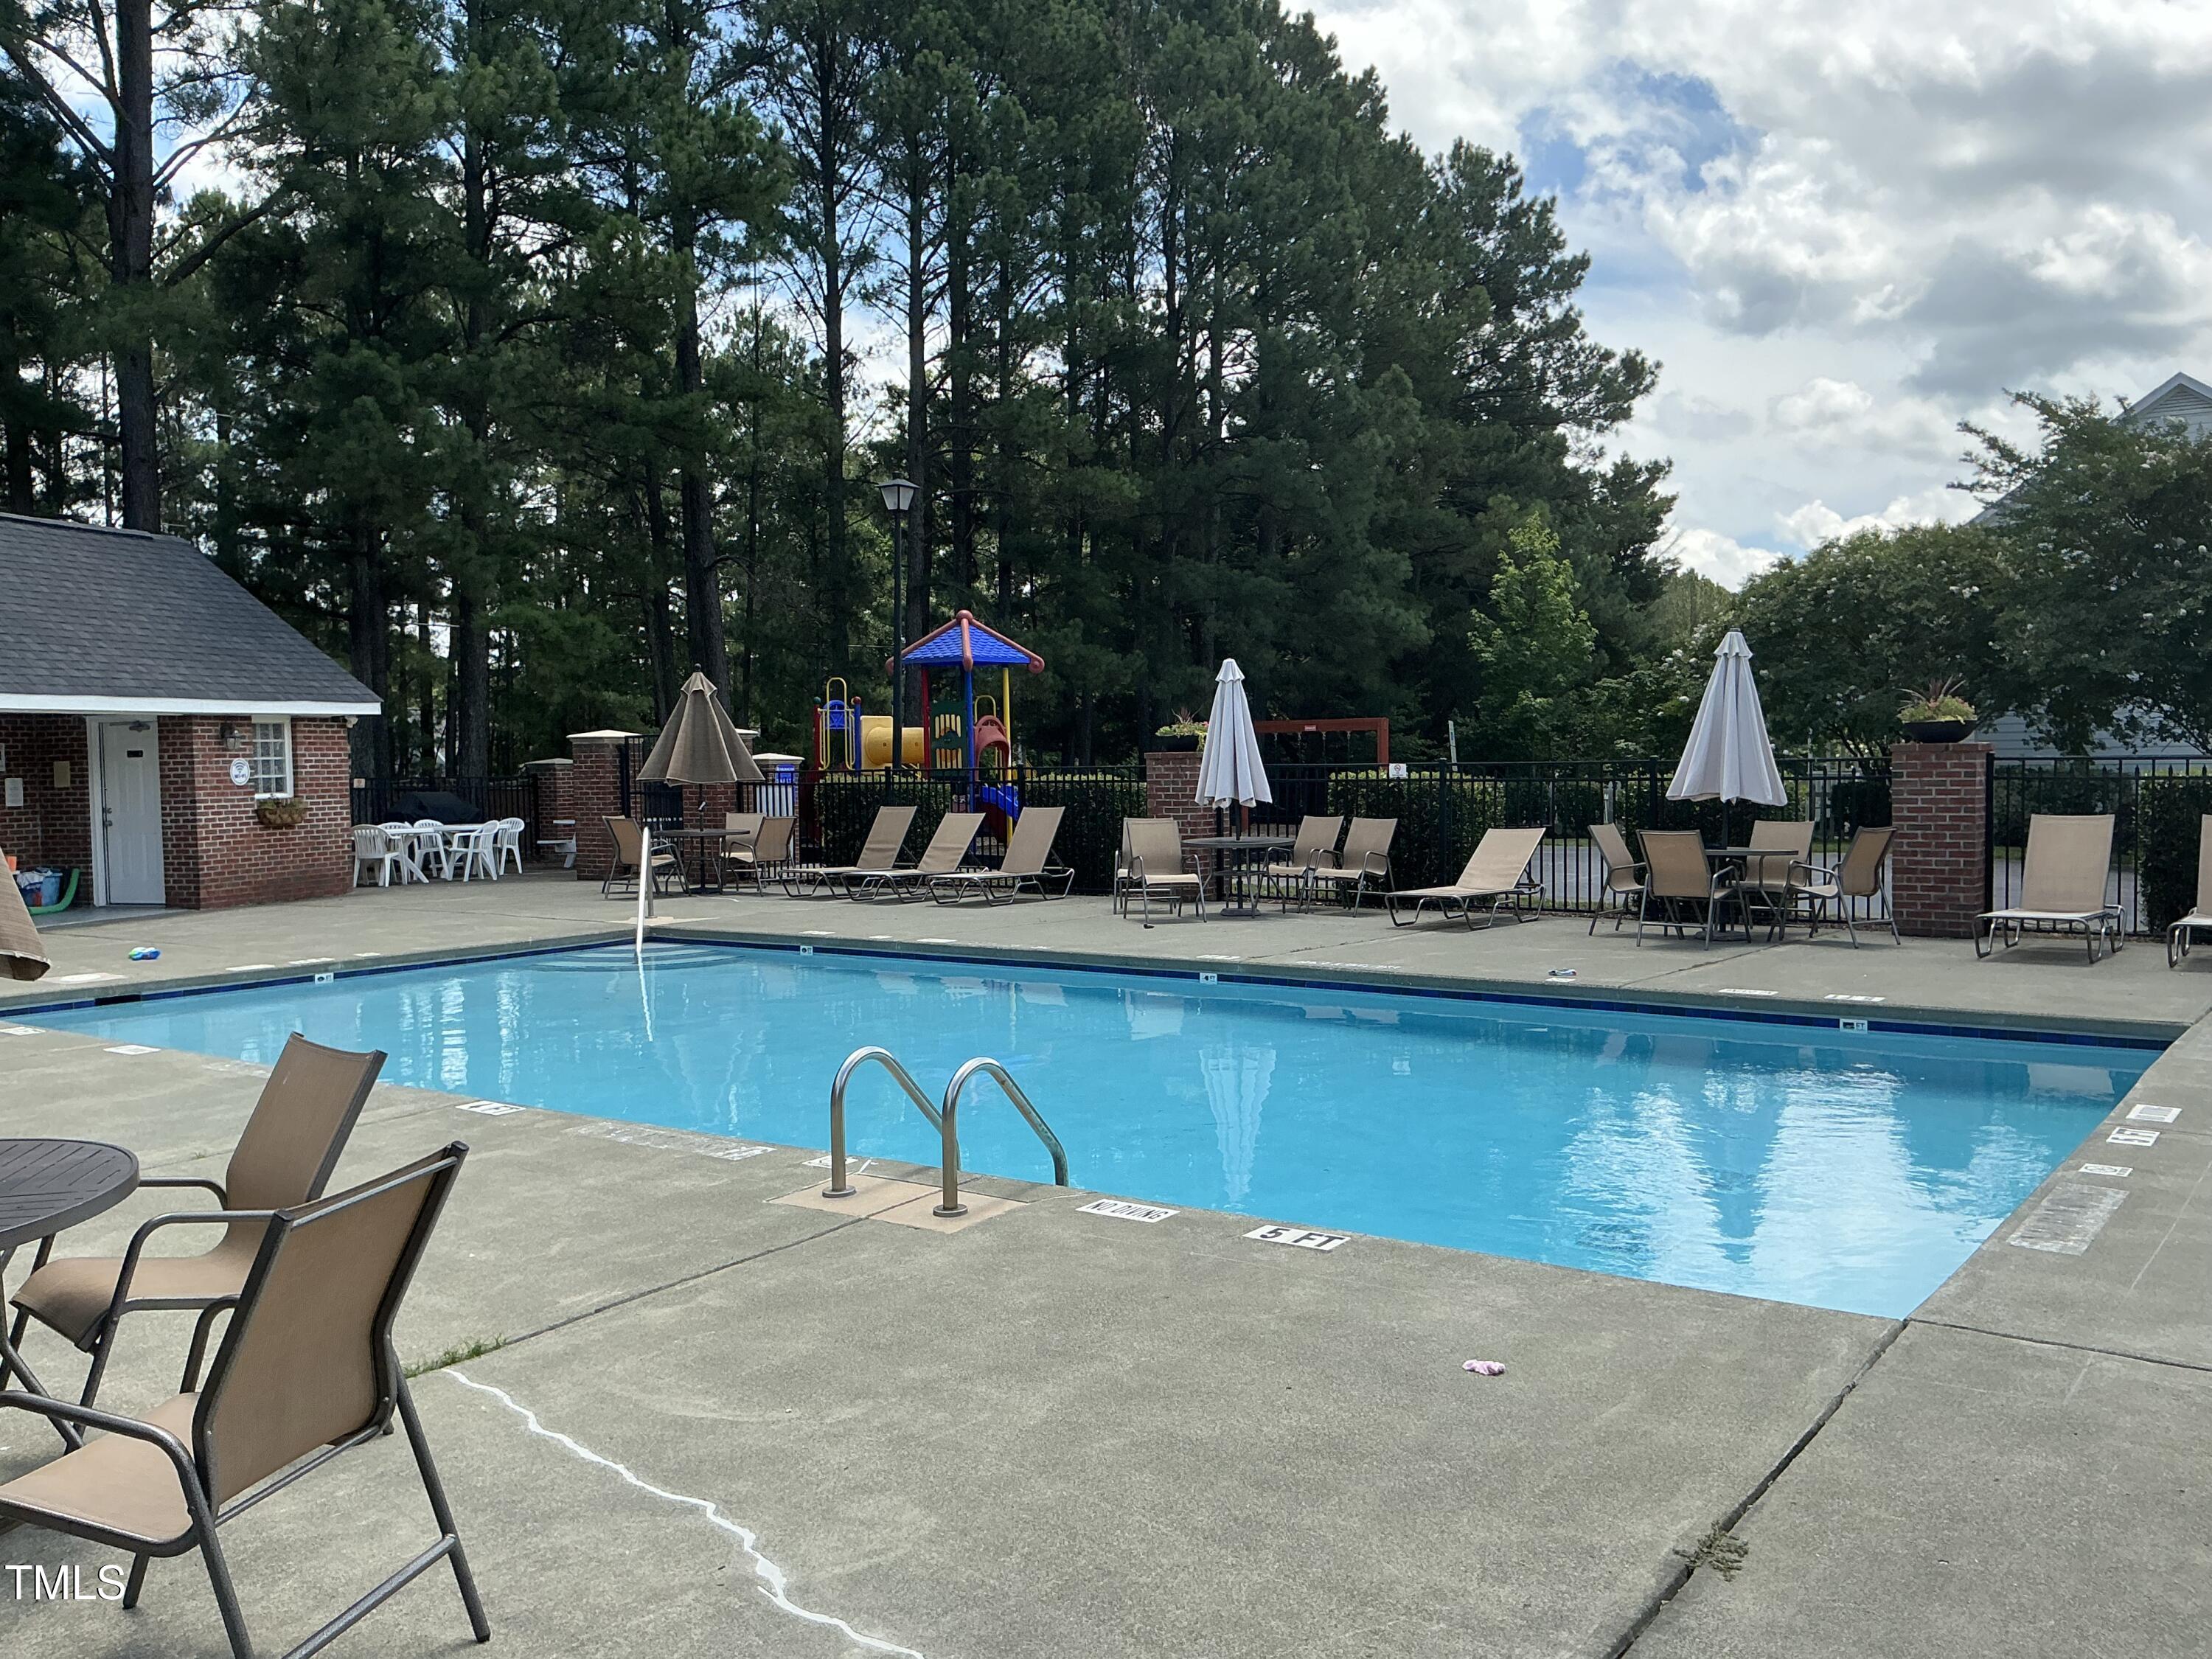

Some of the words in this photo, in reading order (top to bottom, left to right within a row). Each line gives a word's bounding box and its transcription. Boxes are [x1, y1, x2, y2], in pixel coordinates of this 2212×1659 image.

[1086, 1201, 1117, 1211] NO
[1110, 1205, 1169, 1220] DIVING
[1259, 1228, 1290, 1239] 5
[1291, 1232, 1345, 1248] FT
